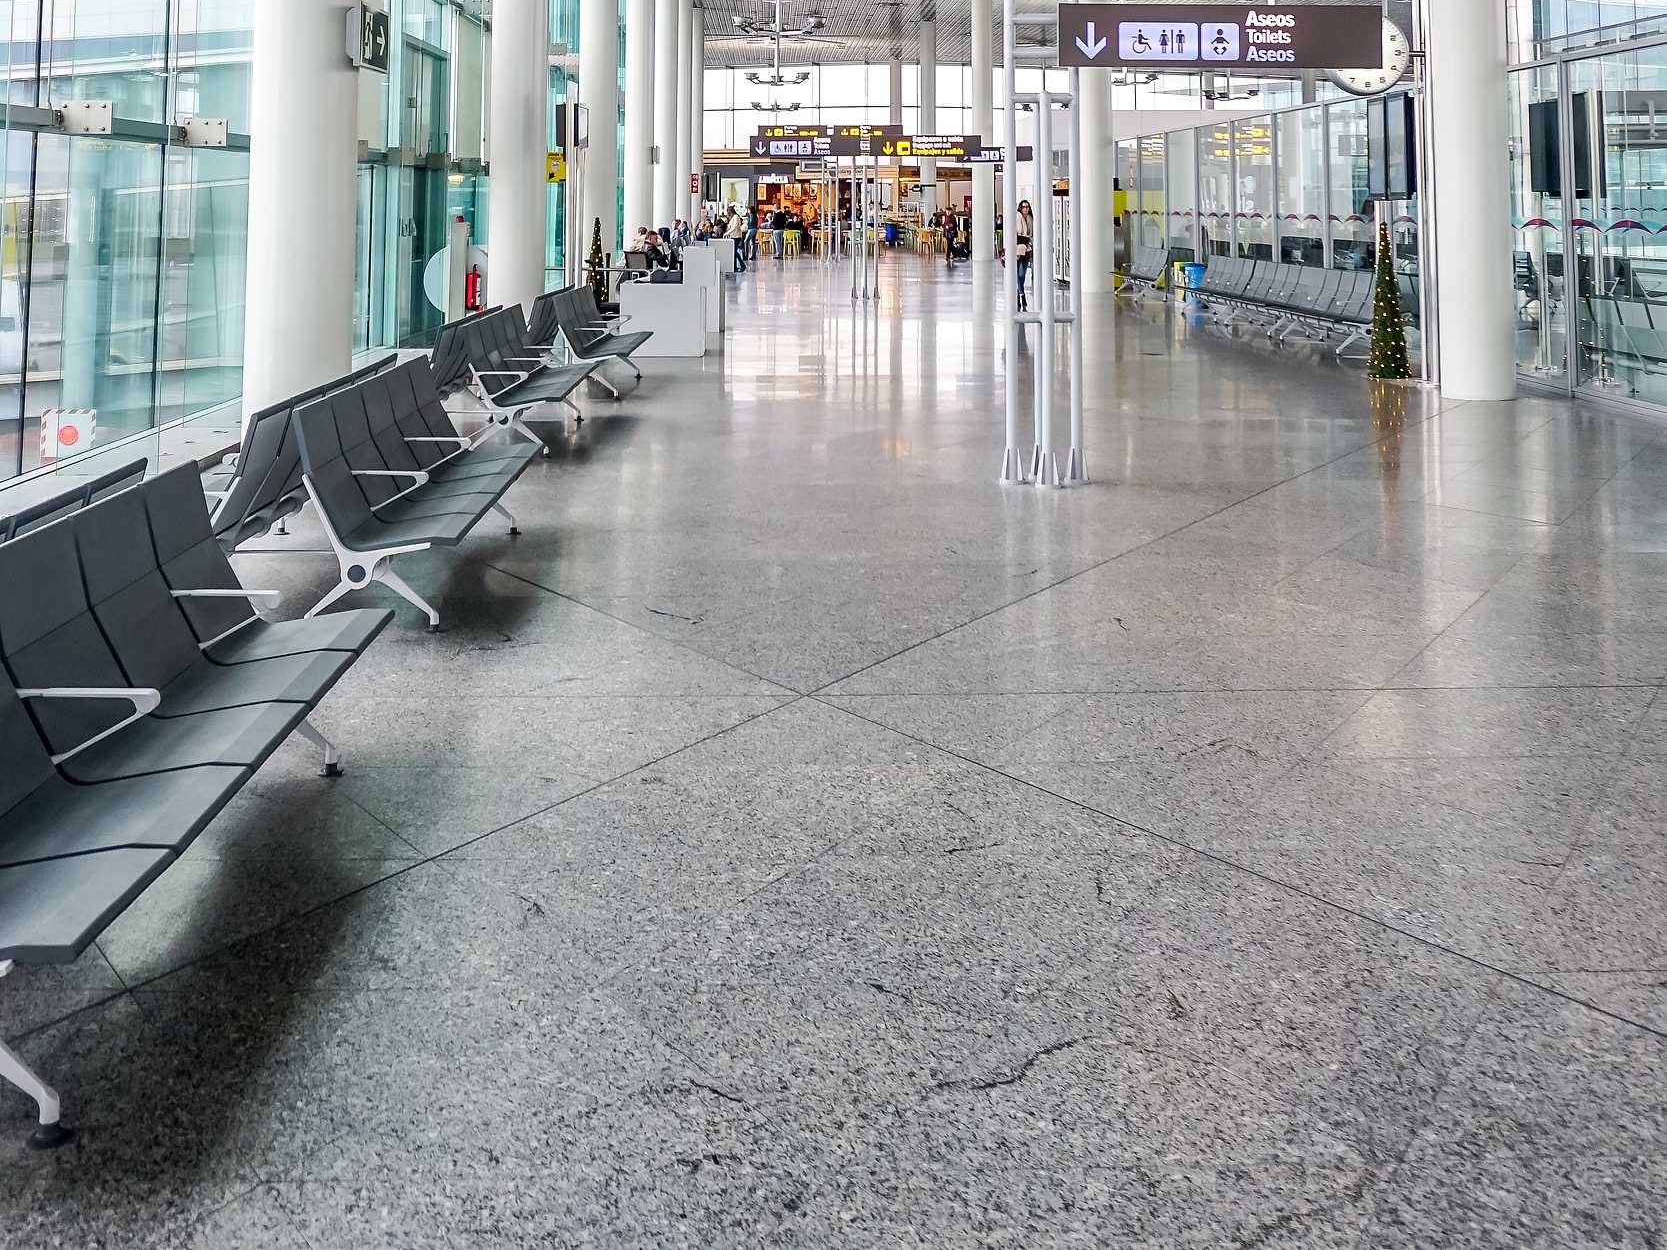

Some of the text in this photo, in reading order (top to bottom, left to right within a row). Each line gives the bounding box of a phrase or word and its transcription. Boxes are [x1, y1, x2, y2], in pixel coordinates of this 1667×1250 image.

[1245, 10, 1296, 28] Aseos
[1245, 29, 1291, 44] Toilets
[1245, 45, 1296, 62] Aseos
